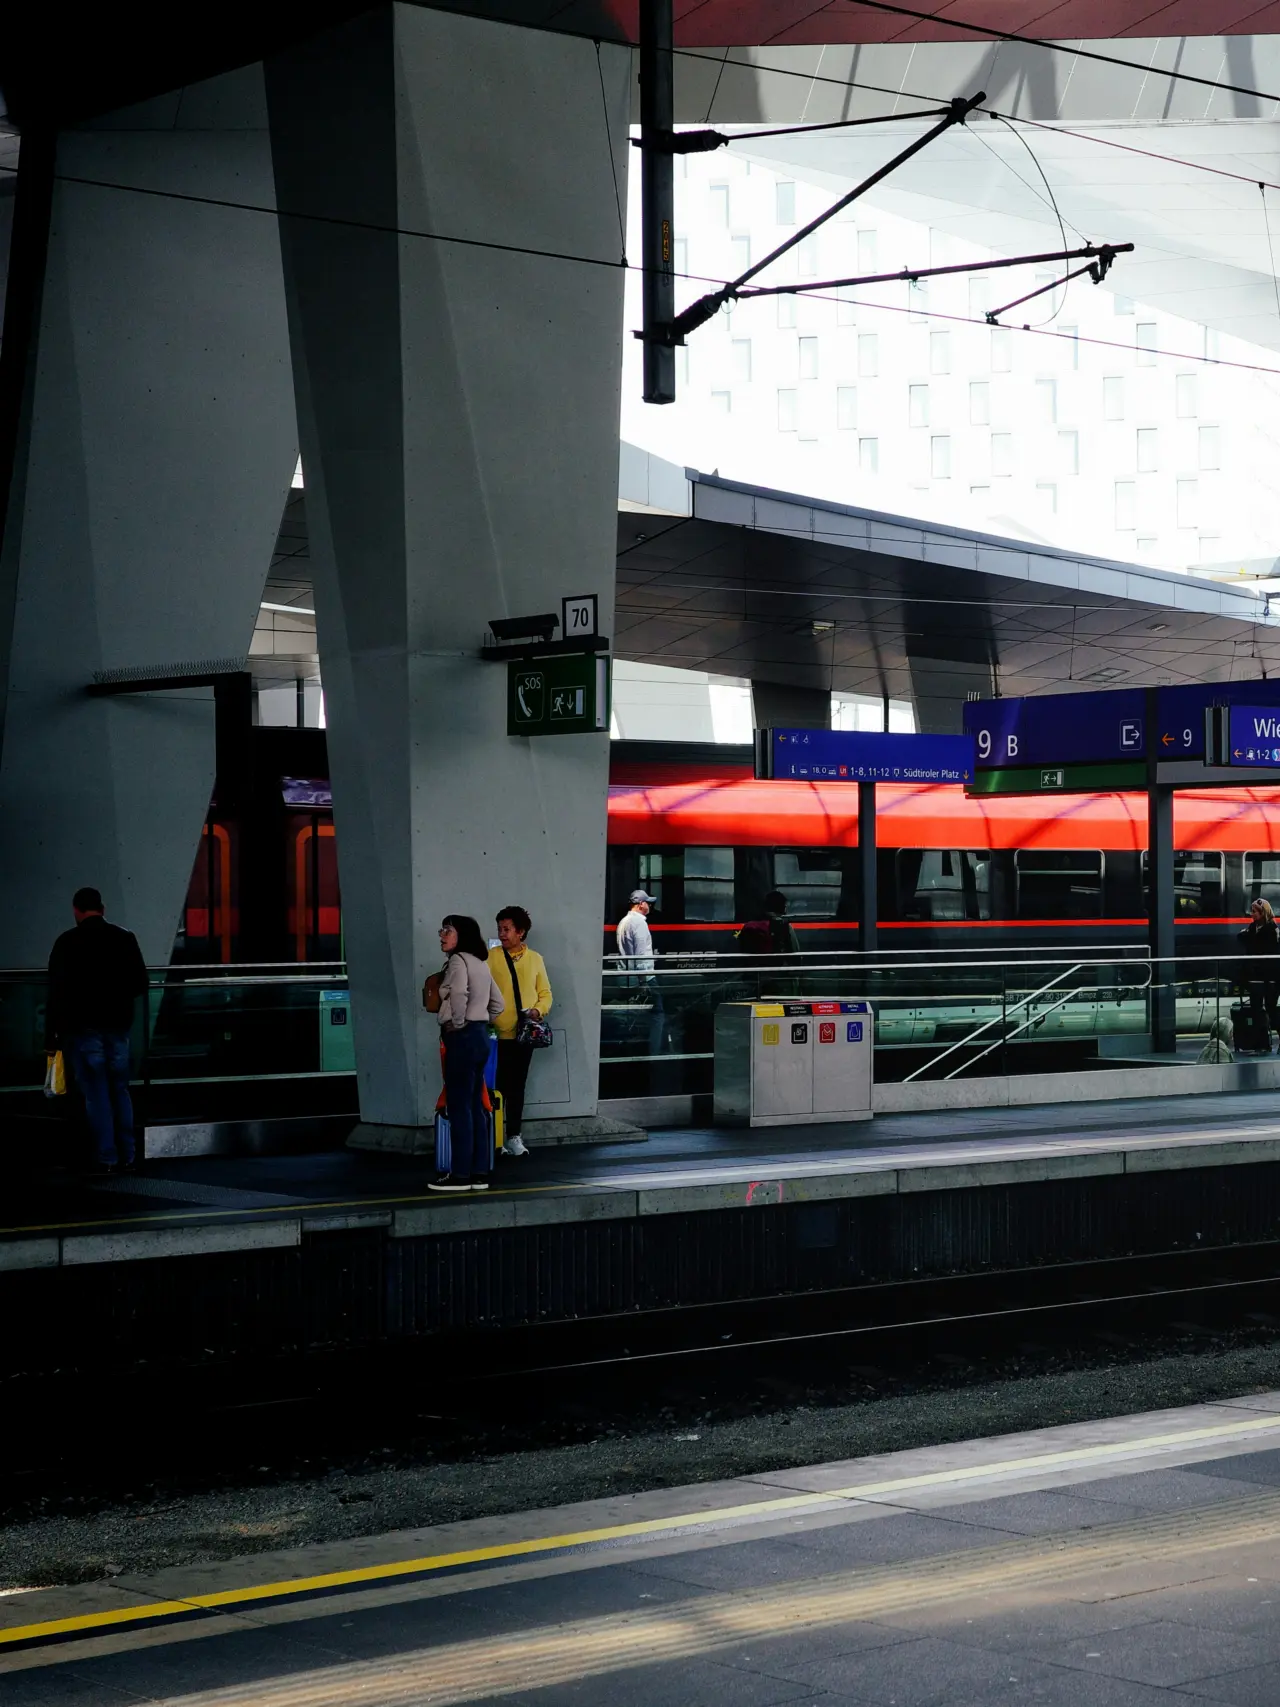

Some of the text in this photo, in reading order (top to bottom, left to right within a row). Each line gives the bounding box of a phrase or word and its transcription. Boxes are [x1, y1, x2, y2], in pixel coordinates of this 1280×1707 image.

[572, 607, 588, 628] 70
[524, 676, 541, 690] SOS
[978, 729, 1018, 759] 9 B
[1183, 729, 1192, 747] 9
[1256, 749, 1270, 760] 1-2
[869, 767, 890, 777] 11-12
[903, 768, 940, 778] Südtiroler
[941, 769, 959, 779] Platz
